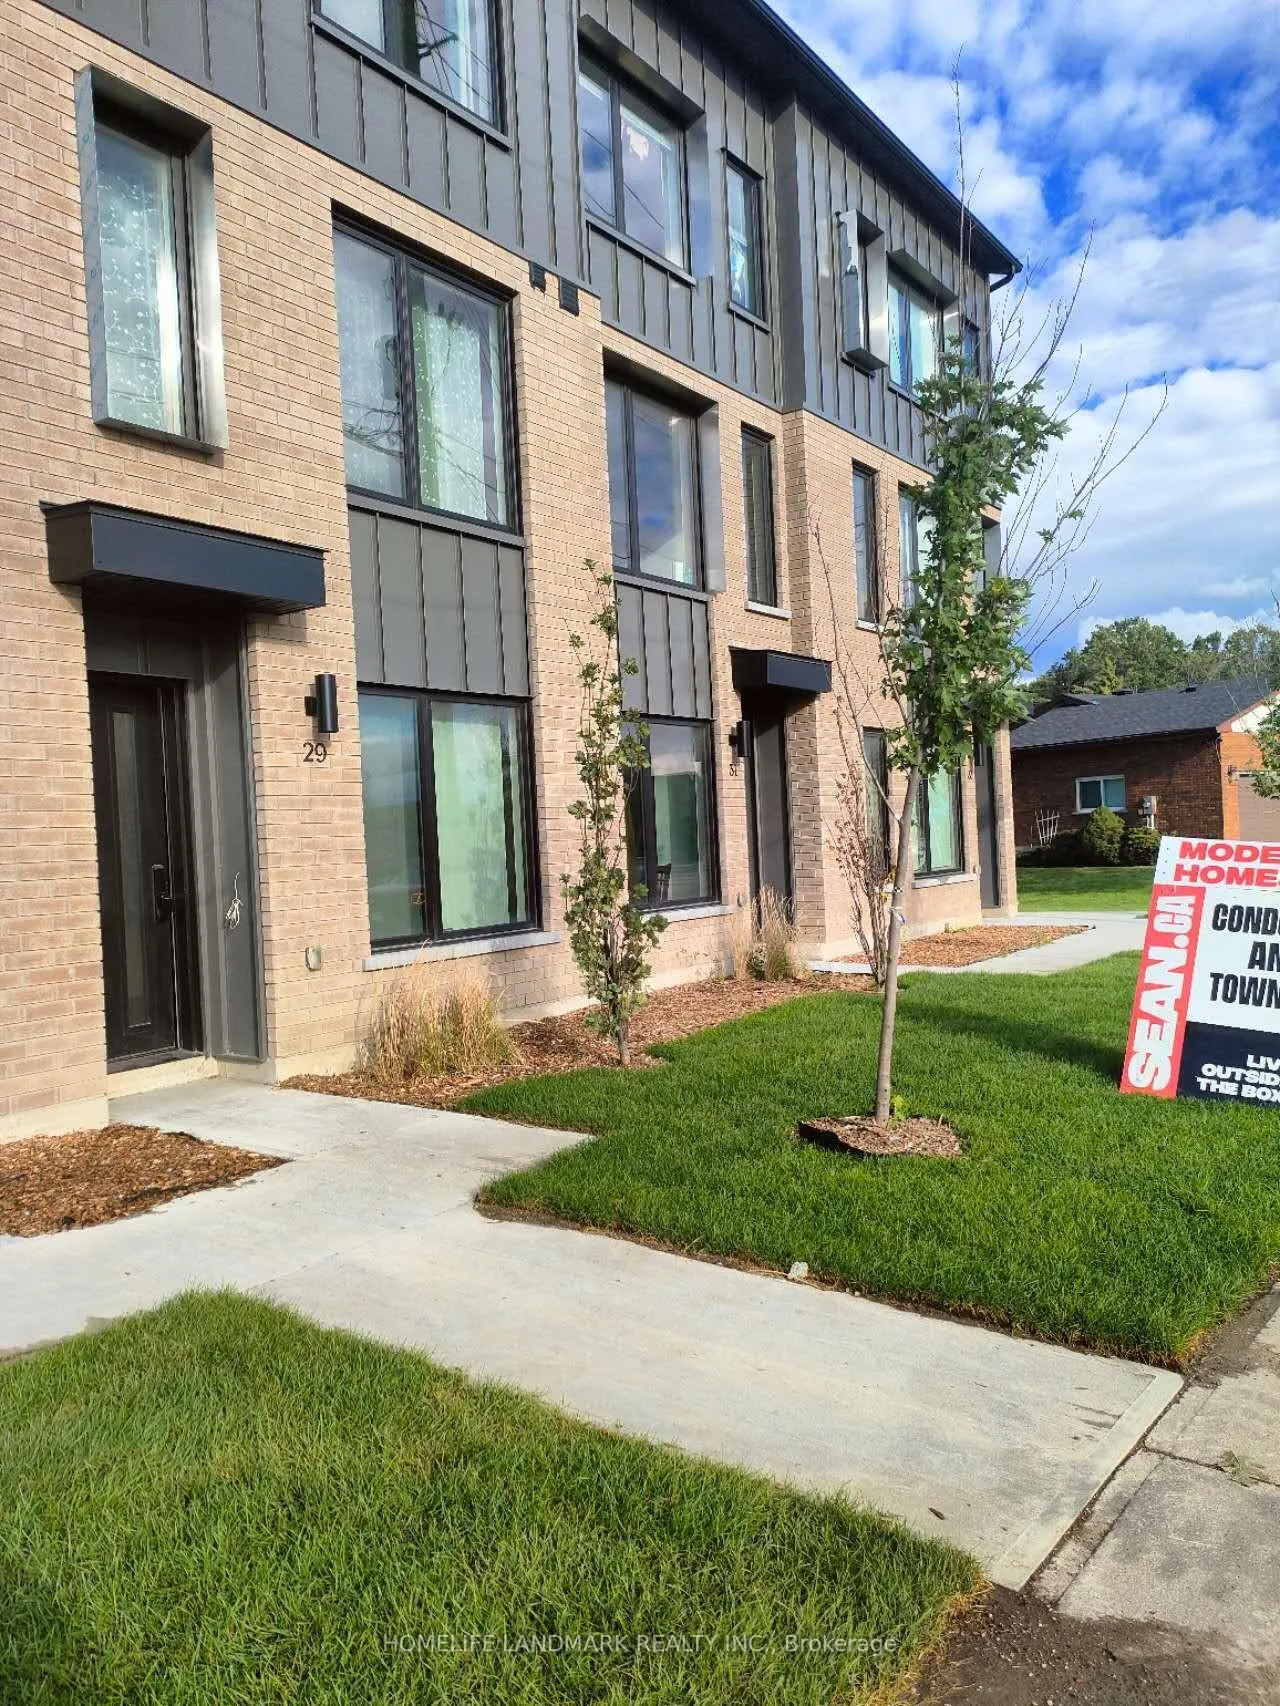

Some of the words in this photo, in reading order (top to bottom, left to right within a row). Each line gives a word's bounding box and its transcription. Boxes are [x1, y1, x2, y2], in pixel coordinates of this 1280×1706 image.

[303, 742, 327, 763] 29
[1174, 864, 1280, 887] HOME
[1212, 903, 1280, 935] COND
[1128, 895, 1196, 1091] SEAN.CA
[1196, 1076, 1239, 1096] THE
[1201, 1063, 1280, 1087] OUTSID
